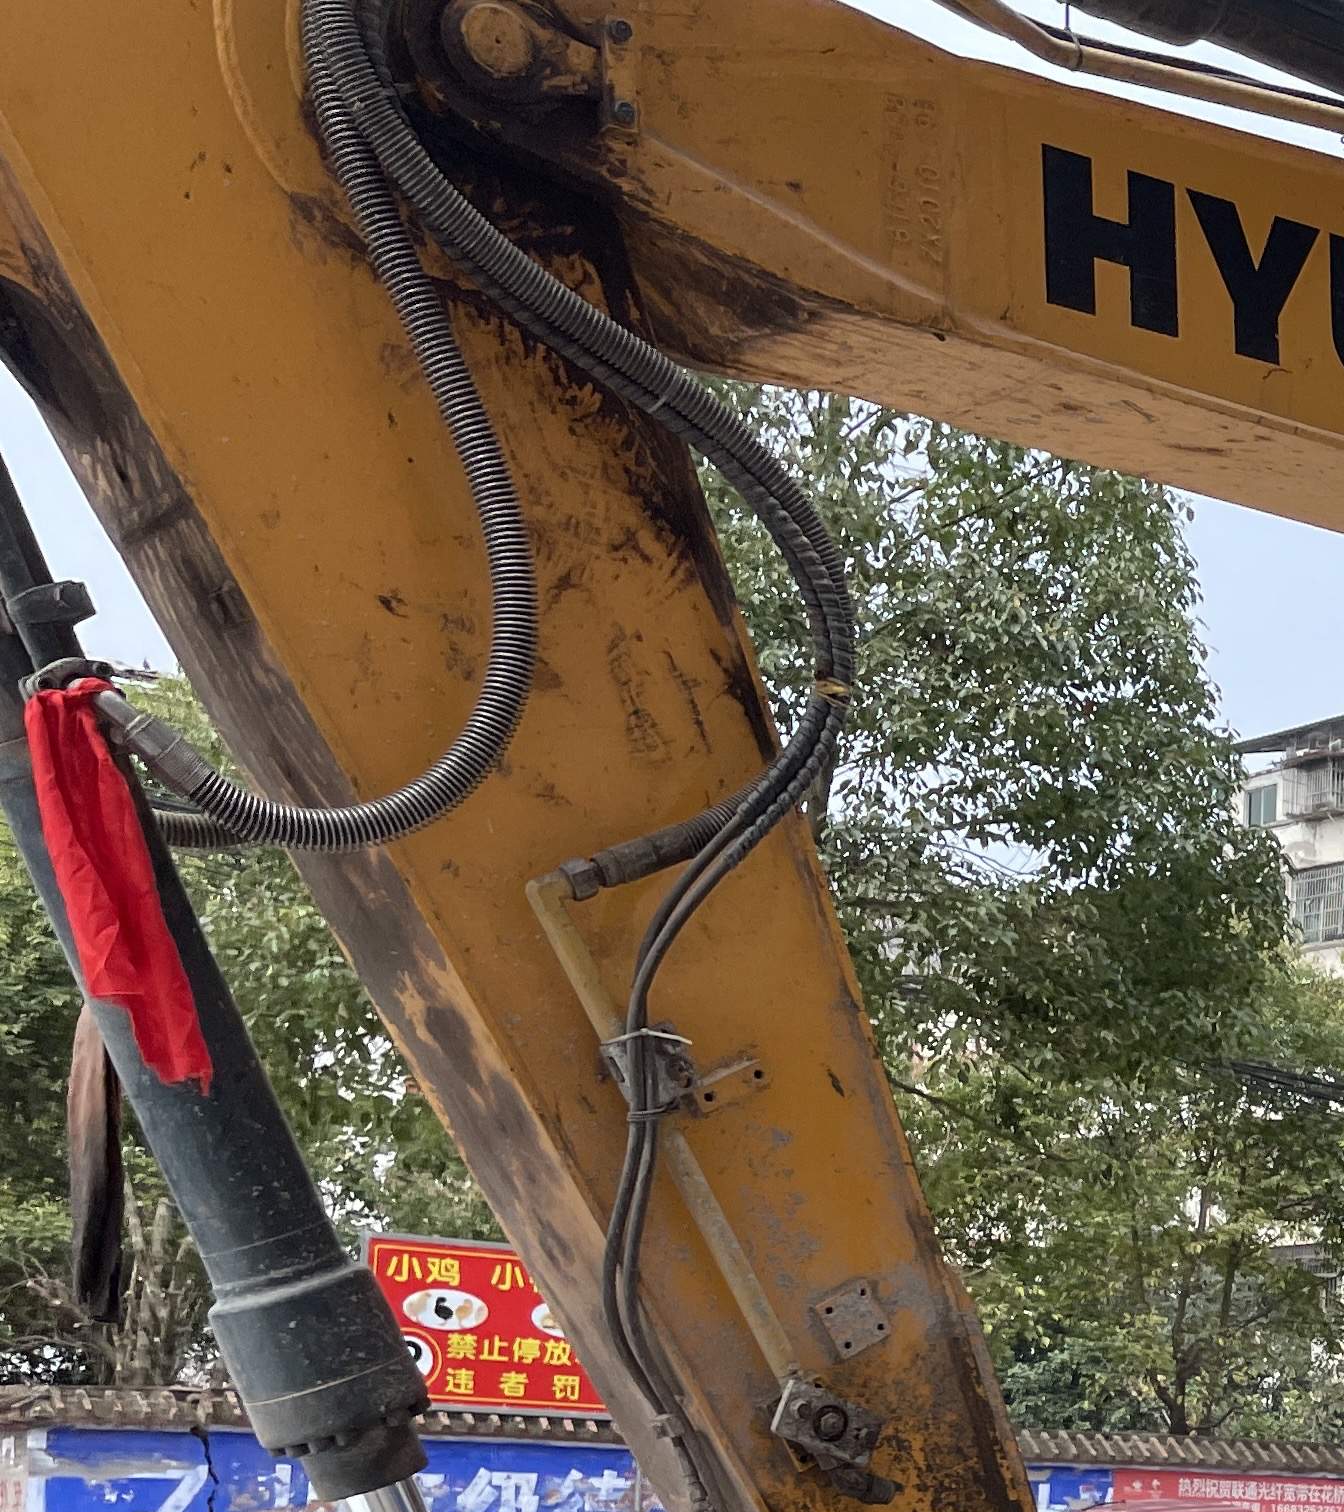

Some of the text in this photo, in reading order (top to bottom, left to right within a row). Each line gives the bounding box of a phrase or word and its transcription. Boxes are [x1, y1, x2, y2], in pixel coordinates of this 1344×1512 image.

[385, 1253, 540, 1294] 小鸡 小
[447, 1332, 580, 1367] 禁止停放
